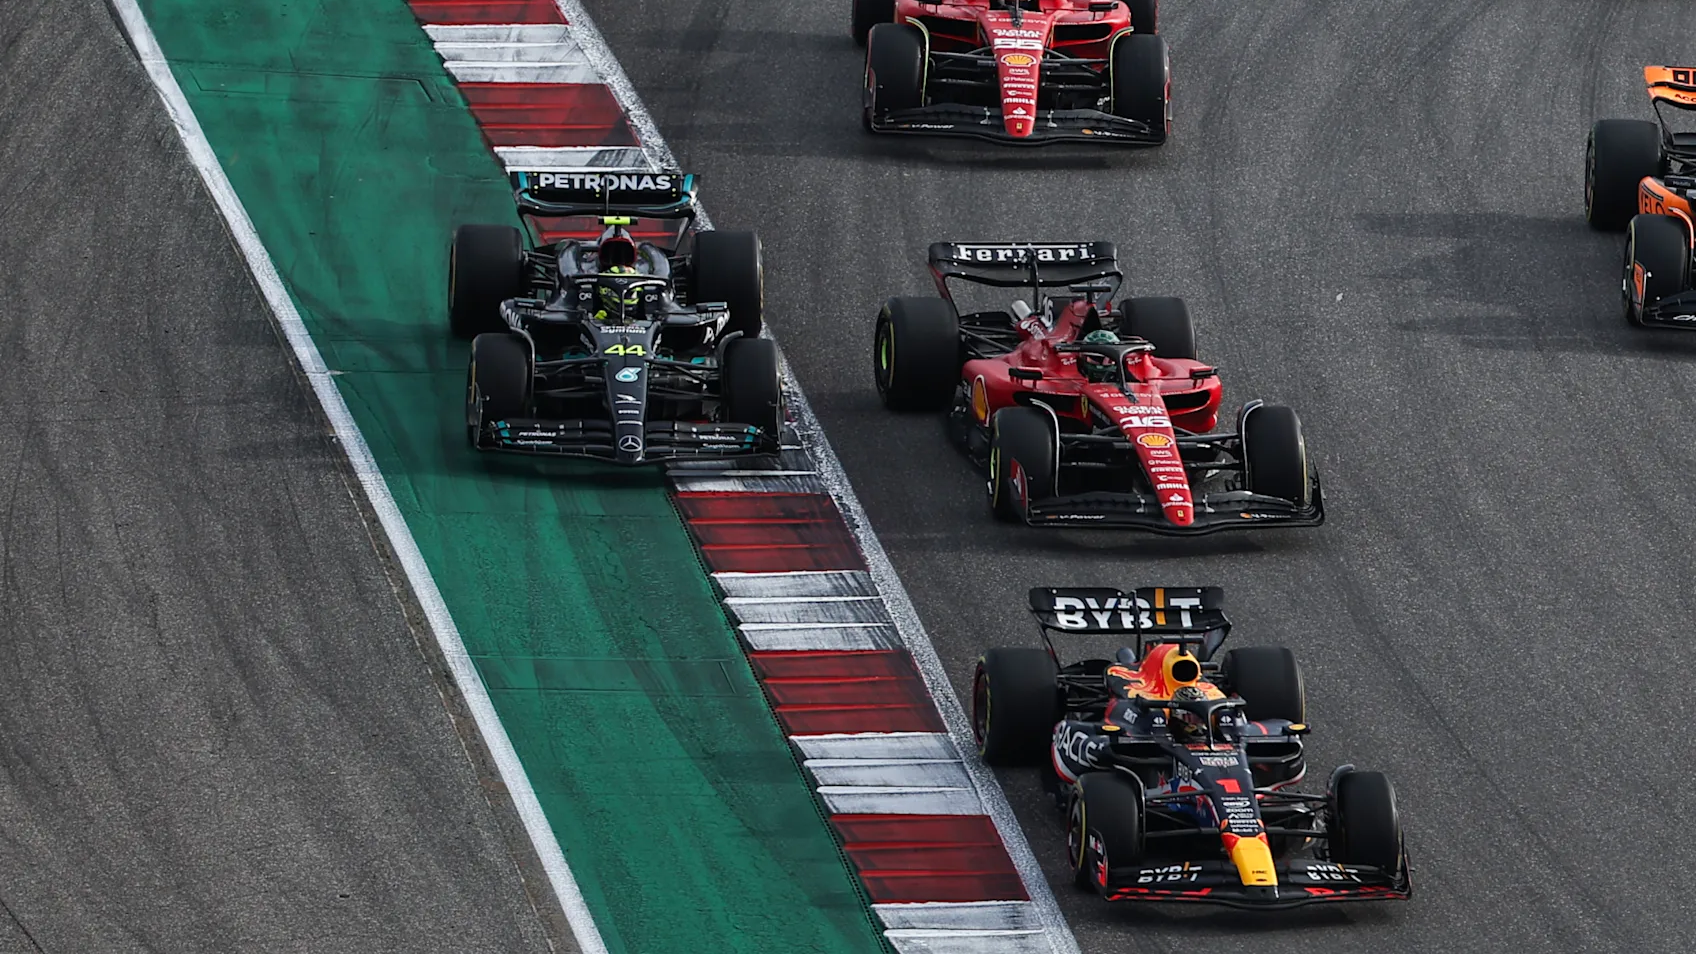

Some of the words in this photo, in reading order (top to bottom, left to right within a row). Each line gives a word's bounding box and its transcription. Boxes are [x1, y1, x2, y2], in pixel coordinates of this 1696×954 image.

[994, 38, 1043, 50] 55
[539, 173, 672, 192] PETRONAS
[604, 344, 647, 356] 44
[1119, 416, 1172, 430] 16
[1054, 588, 1203, 629] BYBIT
[1216, 779, 1242, 793] 1
